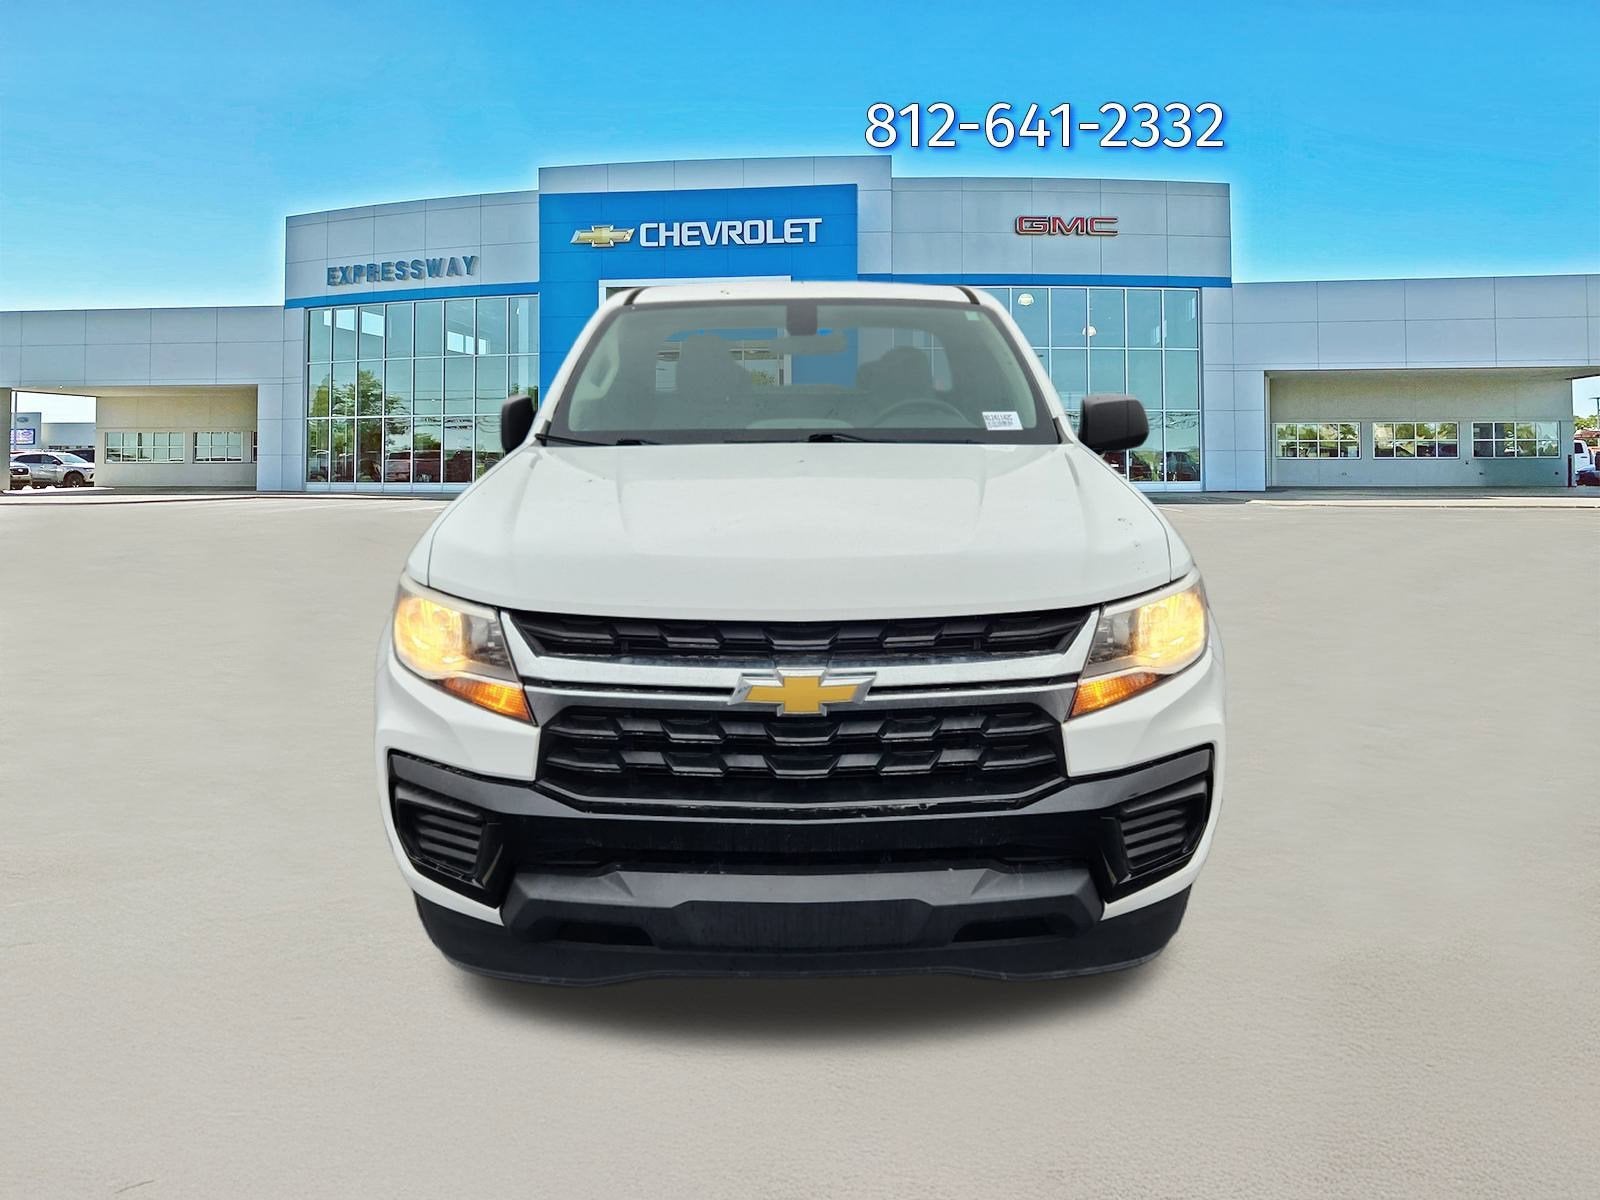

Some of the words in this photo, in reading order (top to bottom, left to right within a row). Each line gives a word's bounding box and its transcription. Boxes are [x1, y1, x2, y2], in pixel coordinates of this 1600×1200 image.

[639, 218, 822, 247] CHEVROLET
[1015, 216, 1119, 235] GMC
[327, 256, 479, 286] EXPRESSWAY
